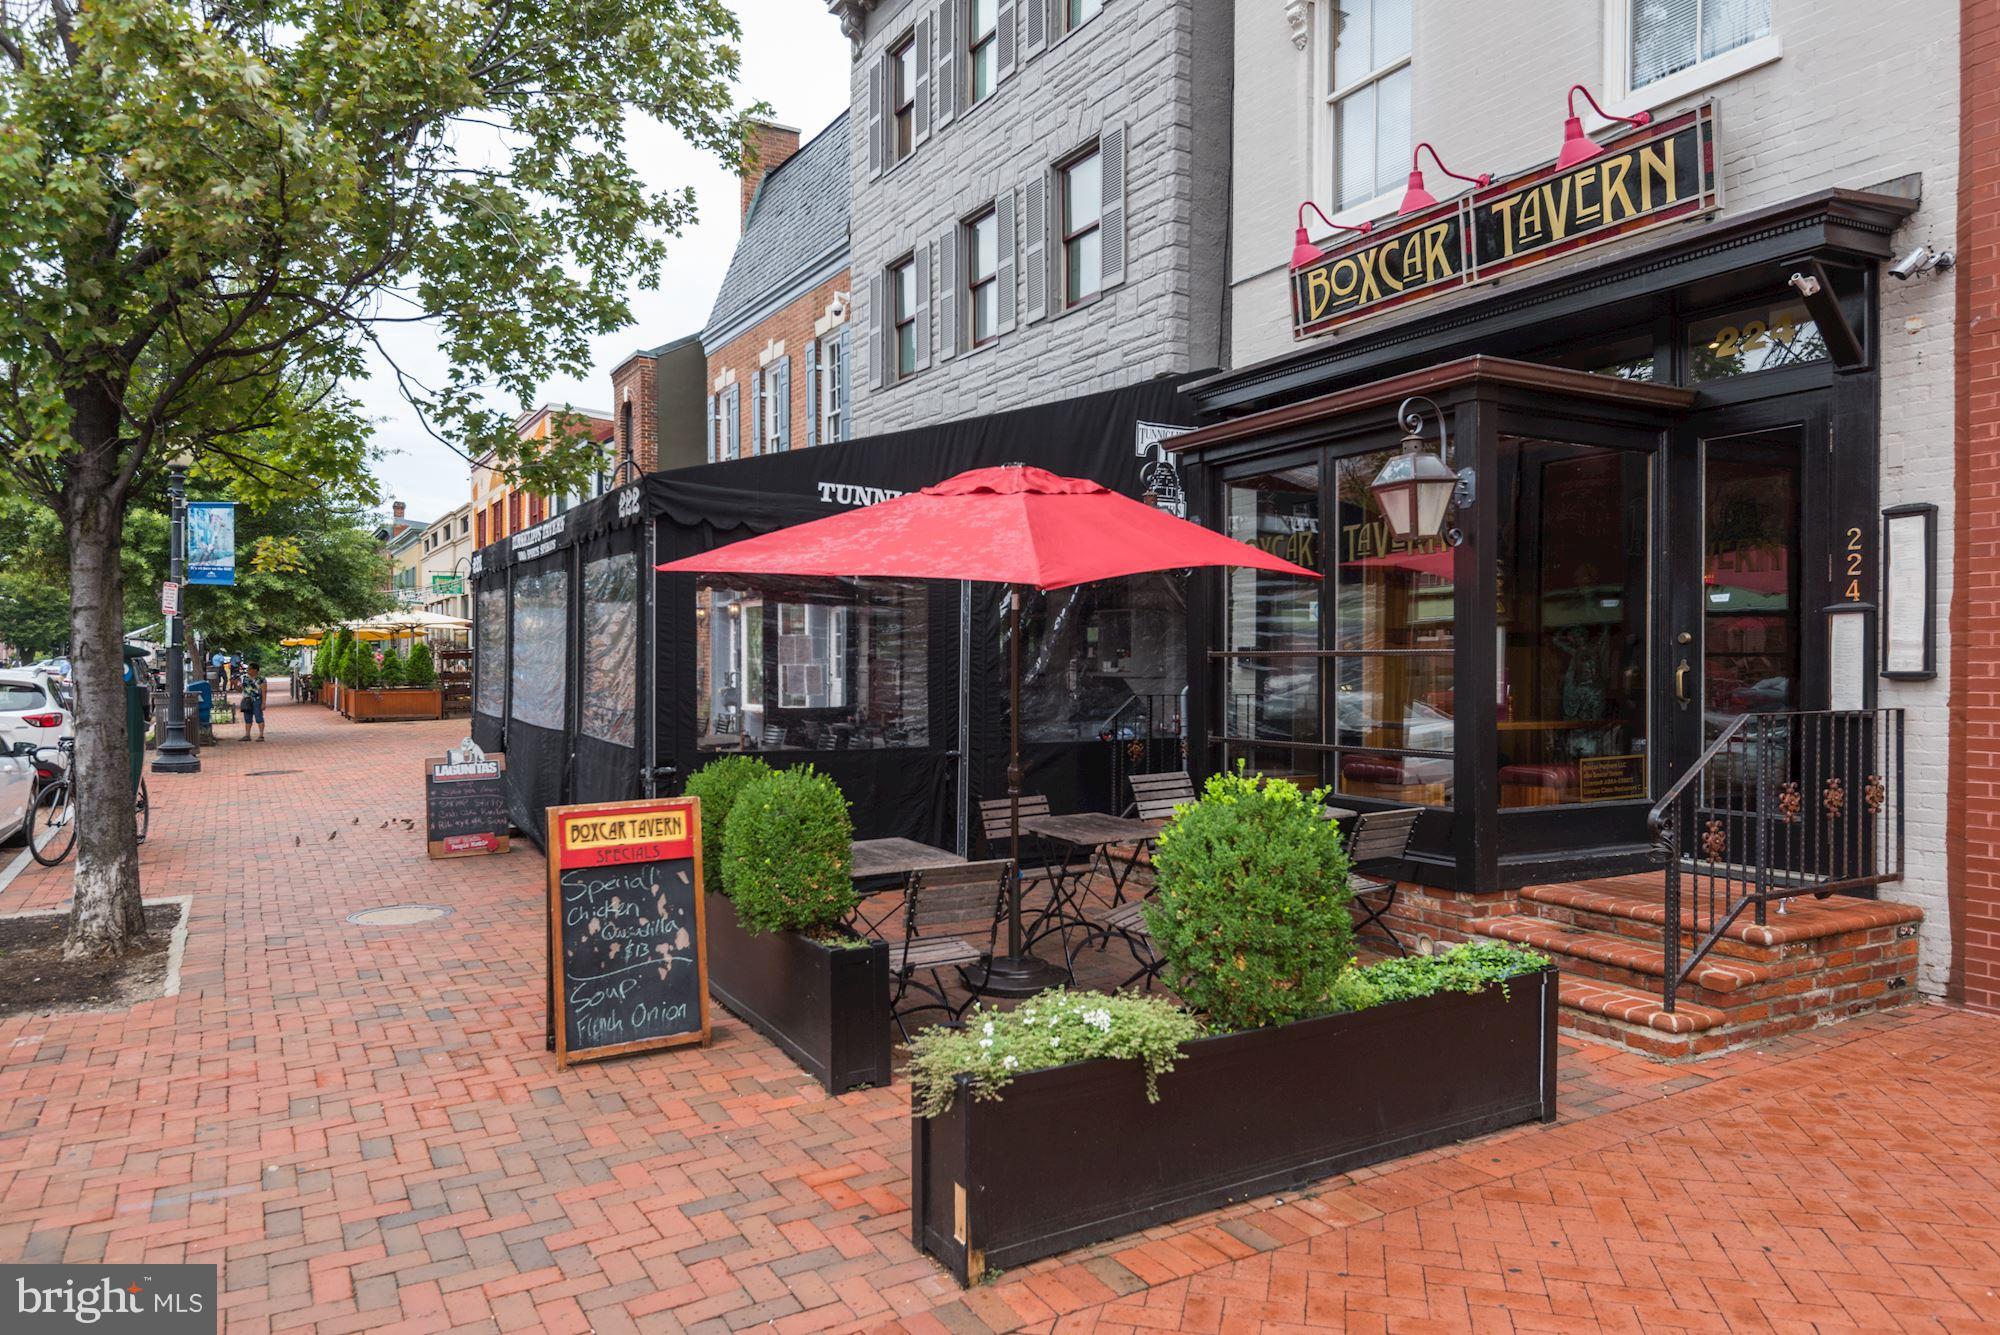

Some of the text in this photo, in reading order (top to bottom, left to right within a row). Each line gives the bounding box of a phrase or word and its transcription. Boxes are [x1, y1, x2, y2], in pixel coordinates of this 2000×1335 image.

[1307, 138, 1677, 321] BOXCAR TAVERN
[1714, 313, 1796, 358] 224
[618, 486, 641, 519] 222
[435, 762, 498, 777] LAGUNITAS
[571, 817, 682, 843] BOXCAR TAVERN
[596, 845, 661, 863] SPECIALS
[625, 940, 650, 962] $13
[631, 1001, 687, 1028] Onion
